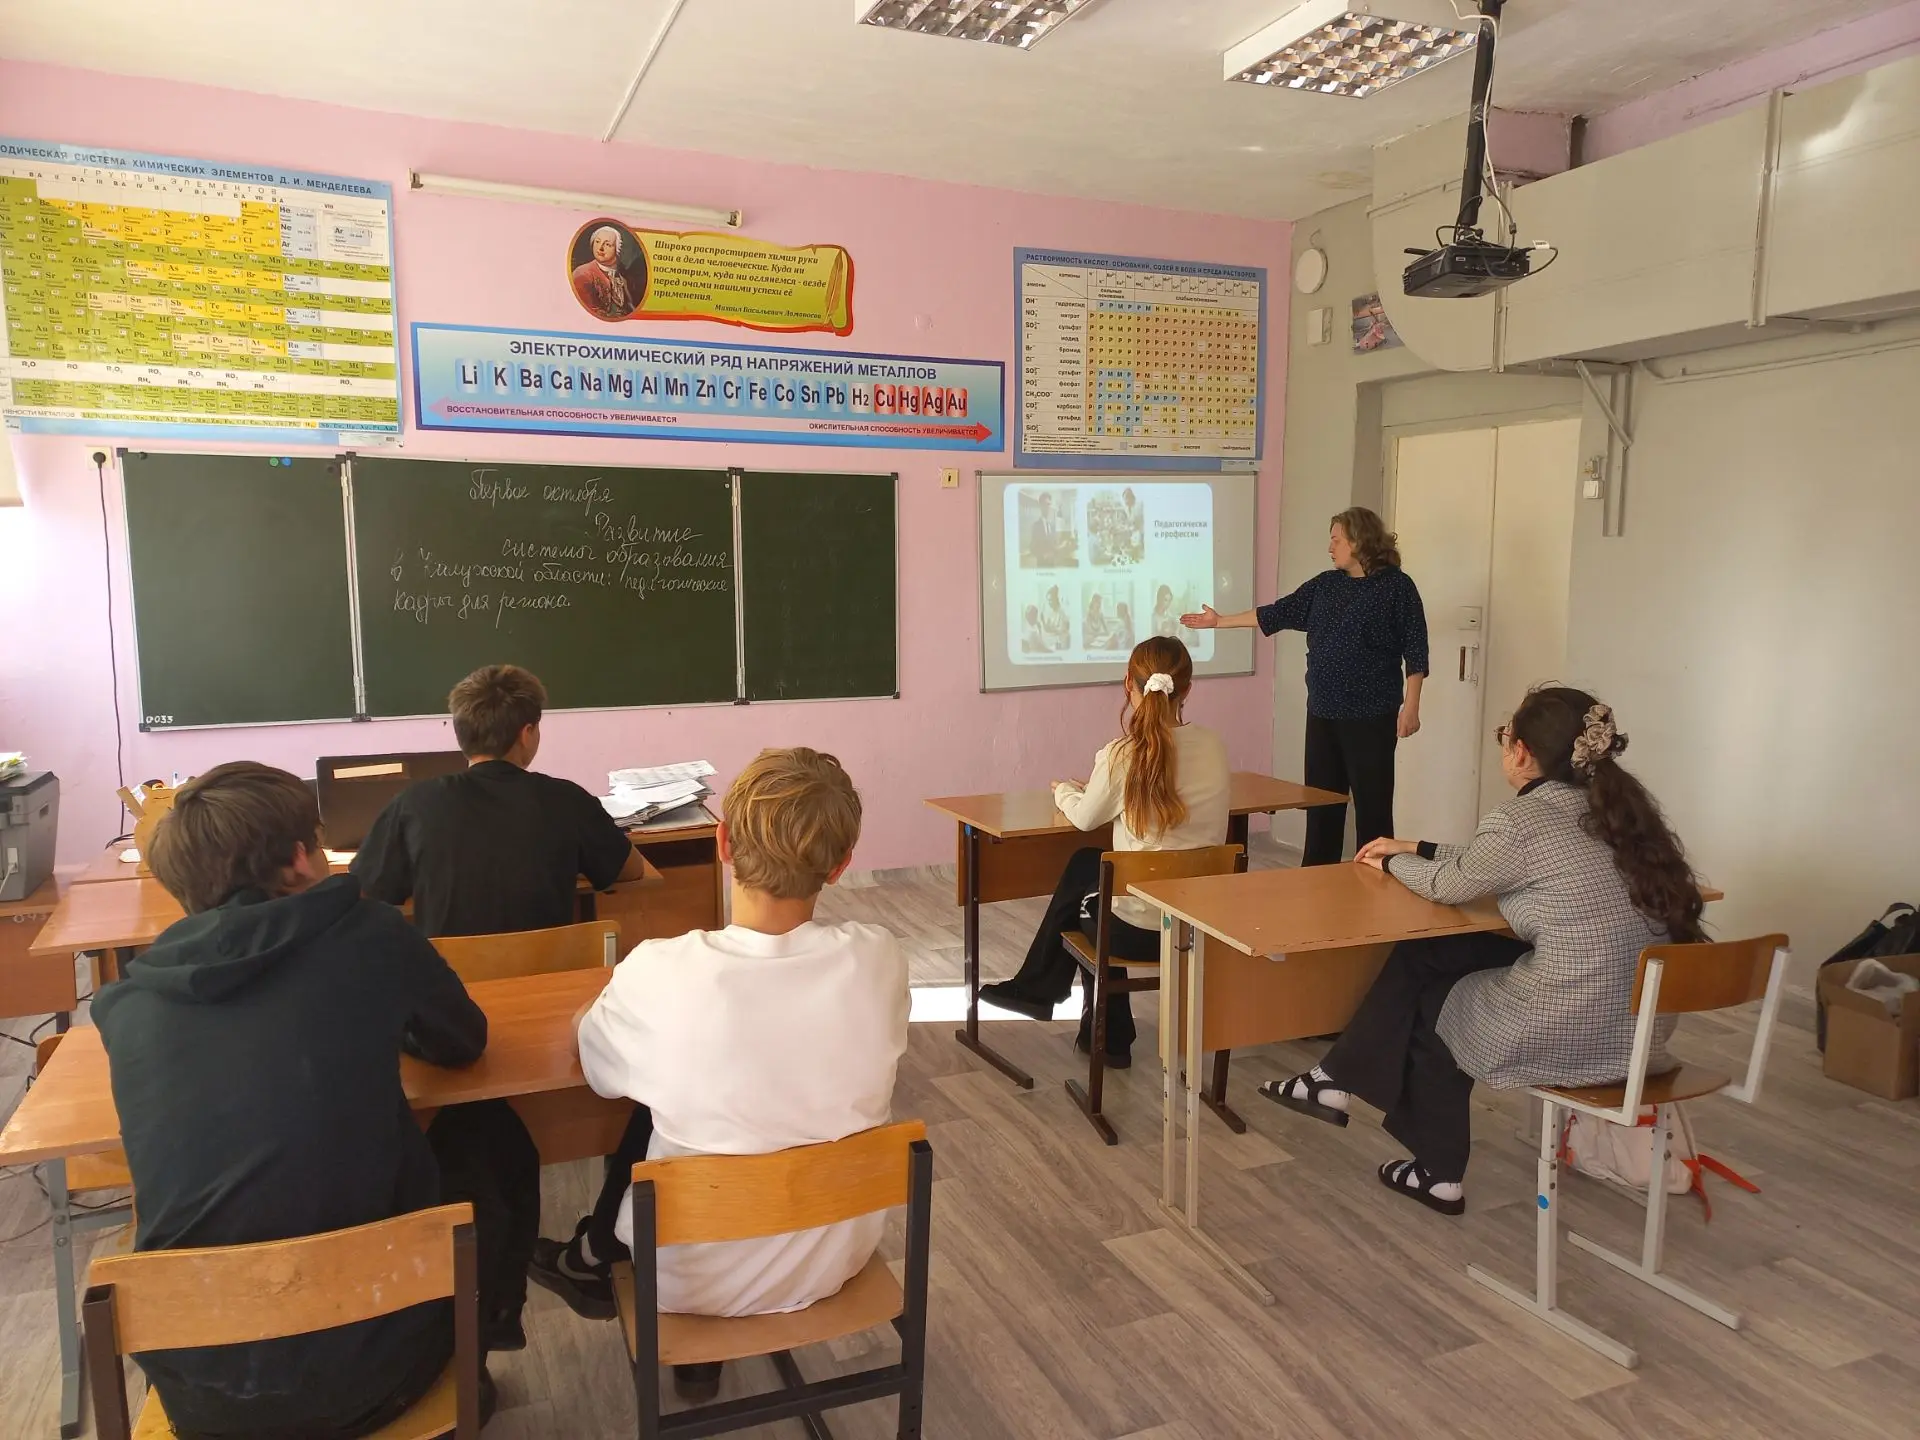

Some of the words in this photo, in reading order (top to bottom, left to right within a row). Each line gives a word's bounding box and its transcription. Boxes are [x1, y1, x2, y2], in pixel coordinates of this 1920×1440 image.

[0, 144, 68, 160] ОДИЧЕСКАЯ
[74, 152, 127, 166] СИСТЕМА
[132, 158, 206, 175] ХИМИЧЕСКИХ
[211, 168, 274, 182] ЭЛЕМЕНТОВ
[280, 176, 290, 185] Д.
[293, 177, 303, 186] И.
[306, 179, 372, 195] МЕНДЕЛЕЕВА
[41, 217, 54, 226] Mg
[72, 256, 84, 264] Zn
[654, 240, 692, 252] Широко
[694, 246, 767, 260] распростирает
[768, 254, 797, 262] химия
[798, 256, 819, 265] руки
[1026, 254, 1082, 264] РАСТВОРИМОСТЬ
[653, 253, 674, 261] свои
[683, 254, 705, 265] дела
[707, 258, 769, 271] человеческие.
[771, 264, 792, 275] Куда
[653, 265, 711, 278] посмотрим,
[713, 270, 734, 280] куда
[749, 275, 796, 285] оглянемся
[802, 280, 827, 288] везде
[653, 277, 680, 288] перед
[682, 281, 711, 289] очами
[713, 283, 751, 293] нашими
[752, 285, 782, 296] успехи
[783, 288, 793, 296] её
[653, 289, 713, 301] применения.
[714, 304, 742, 312] Михаил
[743, 306, 783, 316] Васильевич
[784, 310, 822, 319] Ломоносов
[1059, 345, 1081, 353] бромид
[510, 341, 705, 366] ЭЛЕКТРОХИМИЧЕСКИЙ
[710, 354, 742, 370] РЯД
[747, 357, 853, 375] НАПРЯЖЕНИЙ
[858, 364, 937, 380] МЕТАЛЛОВ
[462, 365, 478, 385] Li
[494, 366, 508, 386] K
[520, 368, 543, 388] Ba
[550, 370, 573, 390] Ca
[580, 372, 602, 392] Na
[608, 374, 633, 398] Mg
[641, 377, 657, 394] Al
[665, 378, 688, 396] Mn
[696, 380, 715, 398] Zn
[724, 381, 741, 399] Cr
[750, 382, 767, 401] Fe
[774, 384, 795, 402] Co
[801, 386, 820, 404] Sn
[826, 387, 845, 404] Pb
[876, 390, 896, 407] Cu
[900, 391, 918, 413] Hg
[924, 392, 943, 413] Ag
[947, 393, 966, 410] Au
[447, 405, 544, 417] ВОССТАНОВИТЕЛЬНАЯ
[546, 410, 608, 420] СПОСОБНОСТЬ
[610, 414, 677, 423] УВЕЛИЧИВАЕТСЯ
[809, 423, 869, 431] ОКИСЛИТЕЛЬНАЯ
[870, 425, 921, 434] СПОСОБНОСТЬ
[469, 469, 530, 509] Первое
[543, 477, 615, 516] октября
[595, 512, 704, 543] Развитие
[1160, 531, 1199, 540] профессии
[502, 539, 597, 560] системы
[606, 542, 734, 580] образования
[458, 594, 489, 619] для
